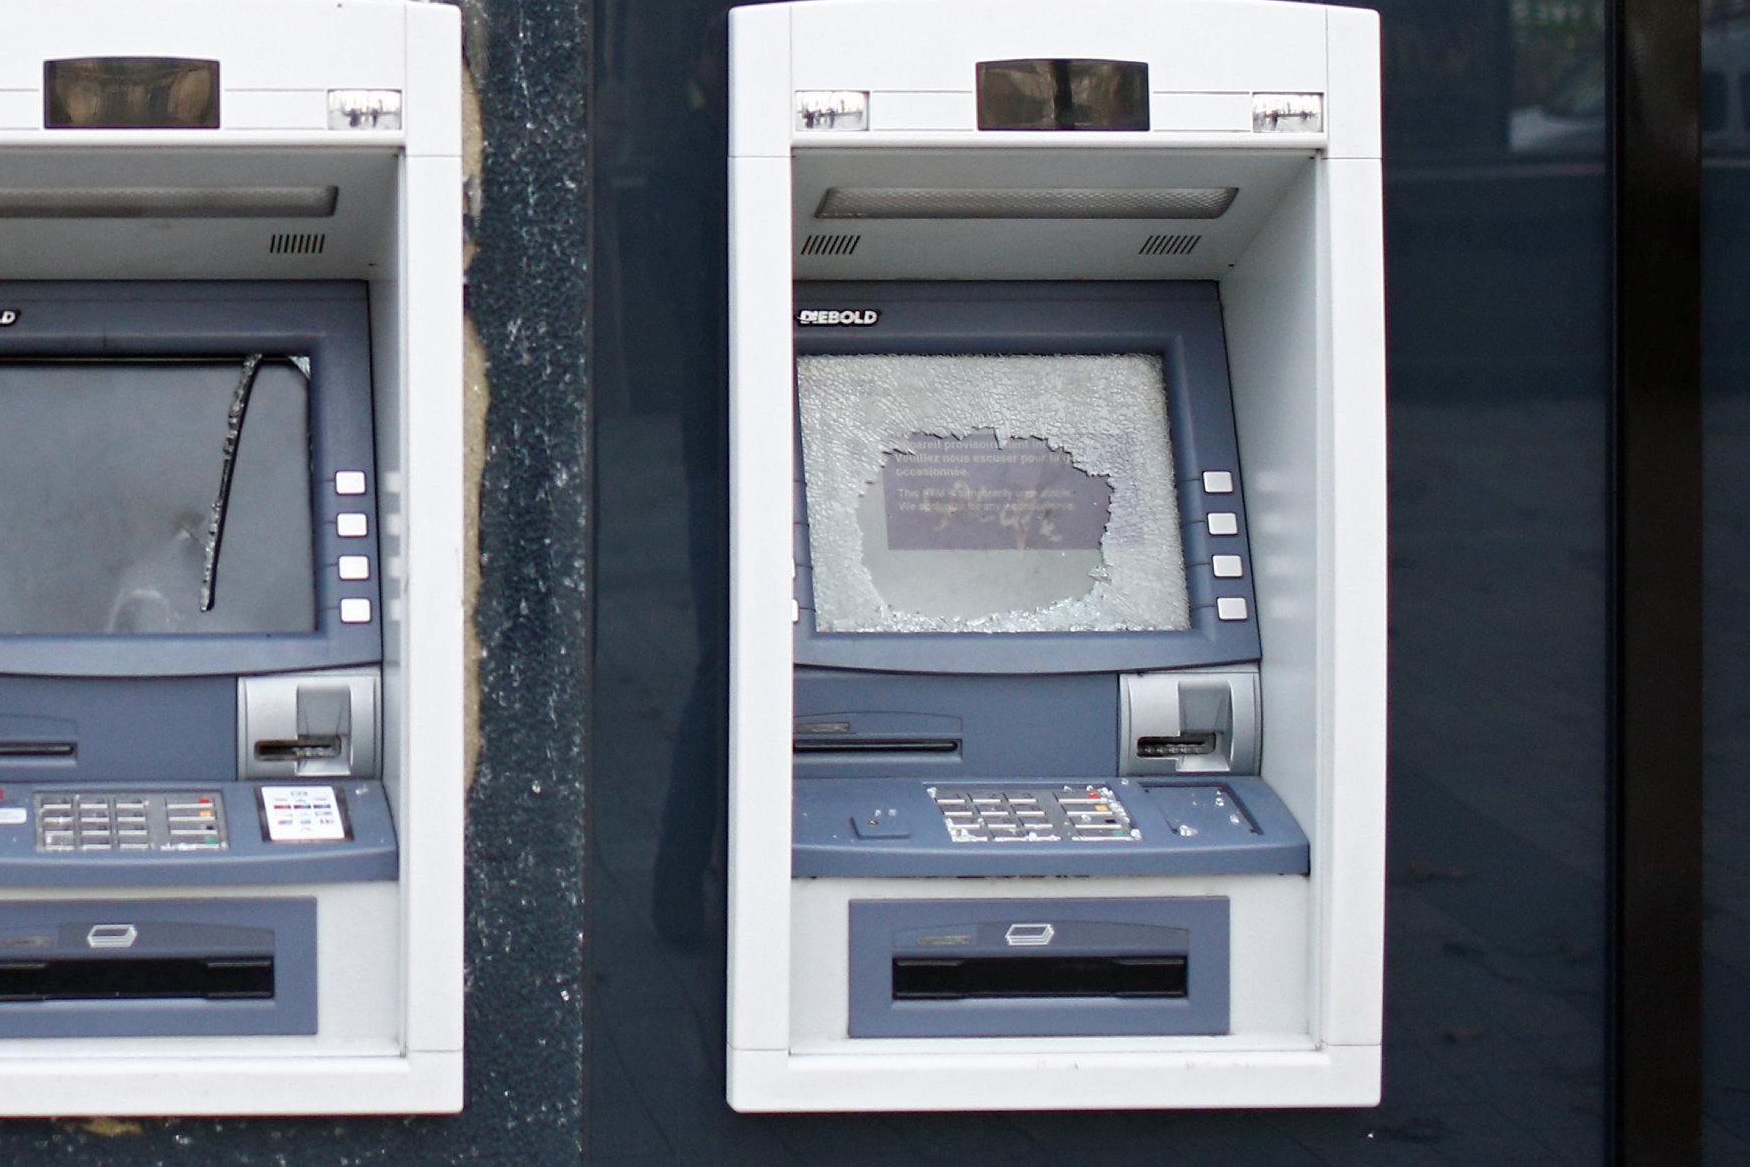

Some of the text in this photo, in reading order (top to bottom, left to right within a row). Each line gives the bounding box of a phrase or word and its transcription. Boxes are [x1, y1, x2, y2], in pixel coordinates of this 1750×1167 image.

[942, 454, 971, 464] nous
[973, 454, 1018, 464] excuser
[1020, 454, 1047, 466] pour
